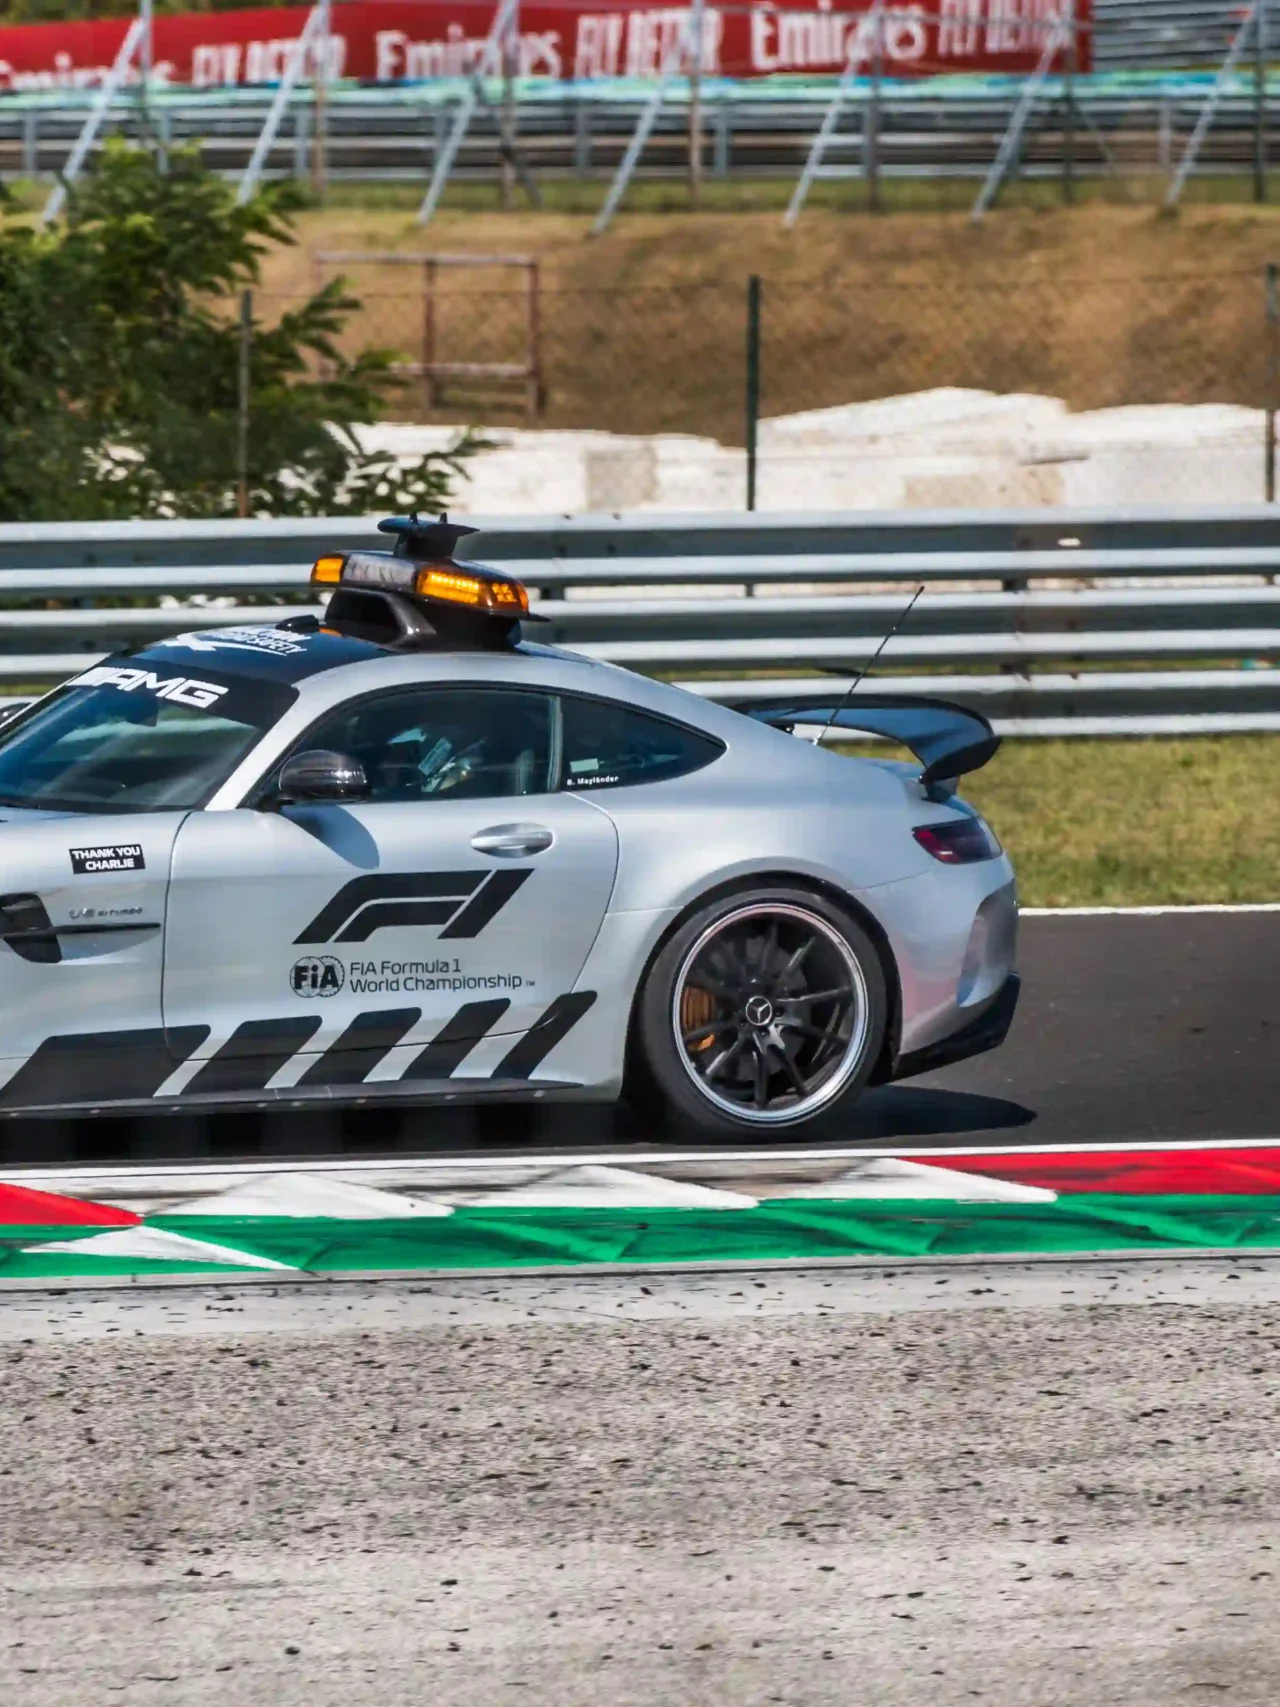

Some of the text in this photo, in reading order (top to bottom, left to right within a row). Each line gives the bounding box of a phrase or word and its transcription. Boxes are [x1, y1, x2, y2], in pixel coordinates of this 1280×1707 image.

[376, 23, 562, 80] Emiraes
[751, 0, 928, 70] Emiraes
[92, 667, 229, 708] AMG
[72, 846, 140, 859] THANK YOU
[85, 858, 135, 870] CHARLIE
[350, 958, 462, 976] FIA Formula 1
[349, 978, 400, 993] World
[403, 974, 522, 992] Championship
